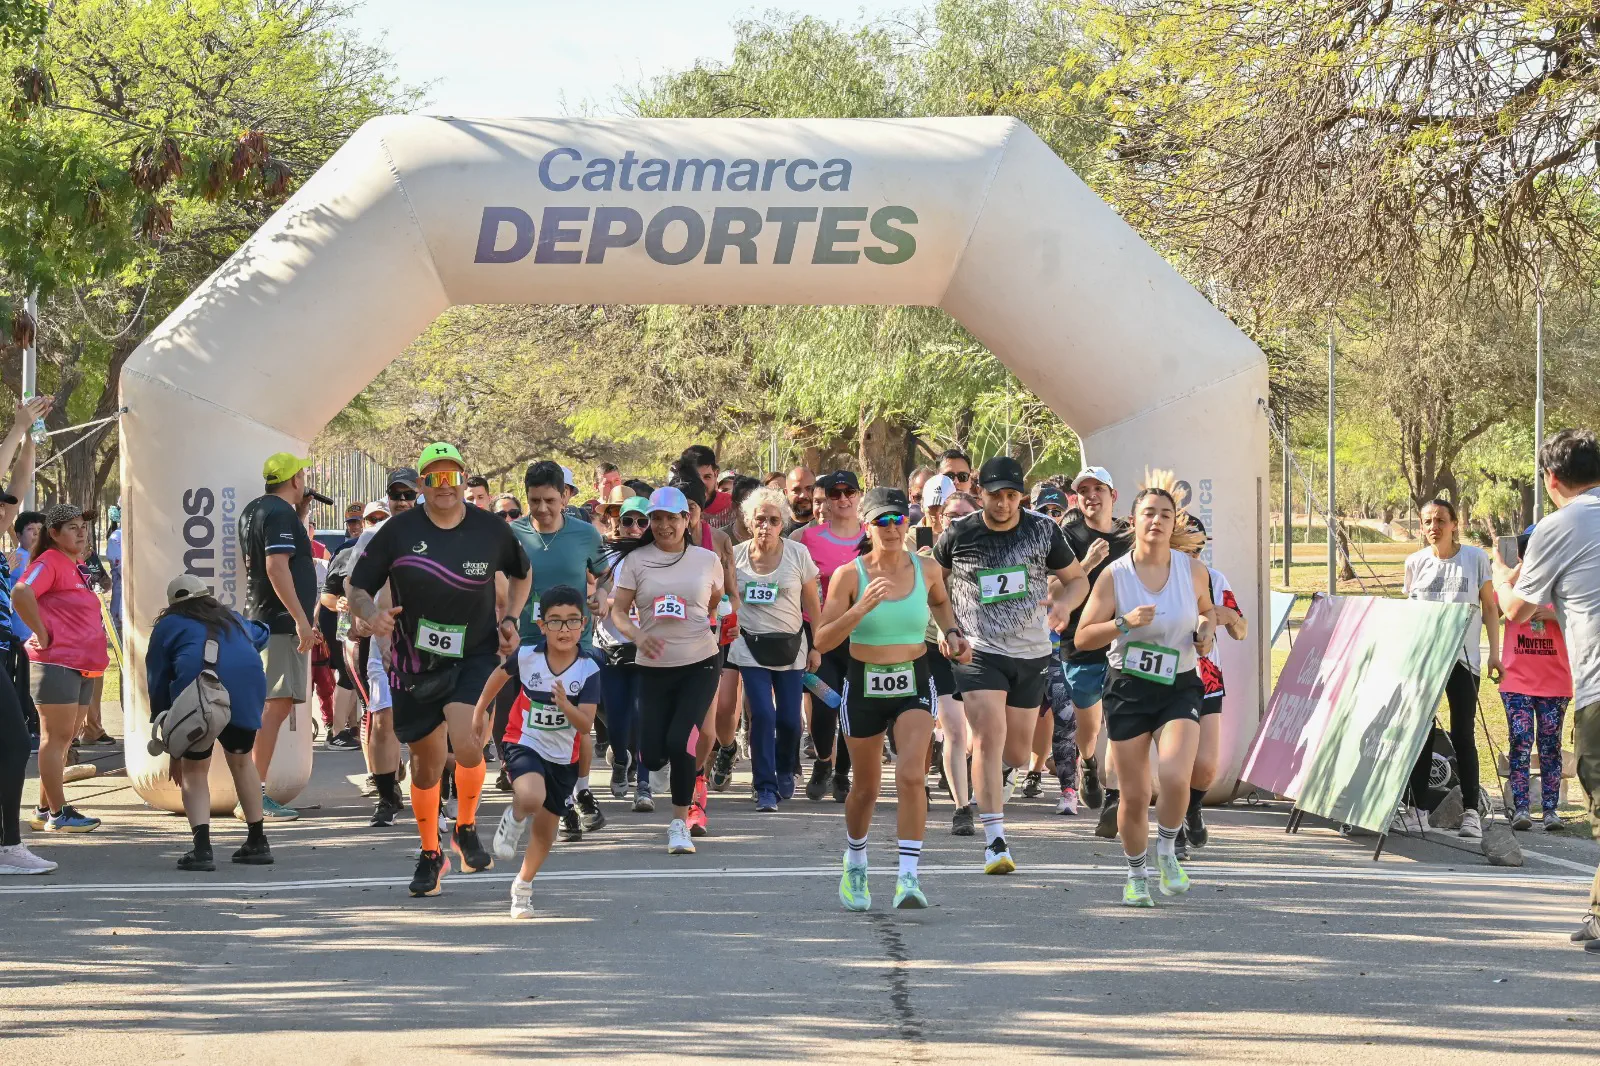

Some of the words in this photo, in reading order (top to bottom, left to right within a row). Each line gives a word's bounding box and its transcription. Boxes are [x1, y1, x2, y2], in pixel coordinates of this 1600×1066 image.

[538, 147, 853, 192] Catamarca
[473, 205, 919, 266] DEPORTES
[996, 574, 1010, 595] 2
[748, 589, 773, 601] 139
[656, 602, 683, 616] 252
[427, 632, 452, 650] 96
[1139, 650, 1163, 675] 51
[871, 674, 909, 692] 108
[534, 712, 566, 727] 115
